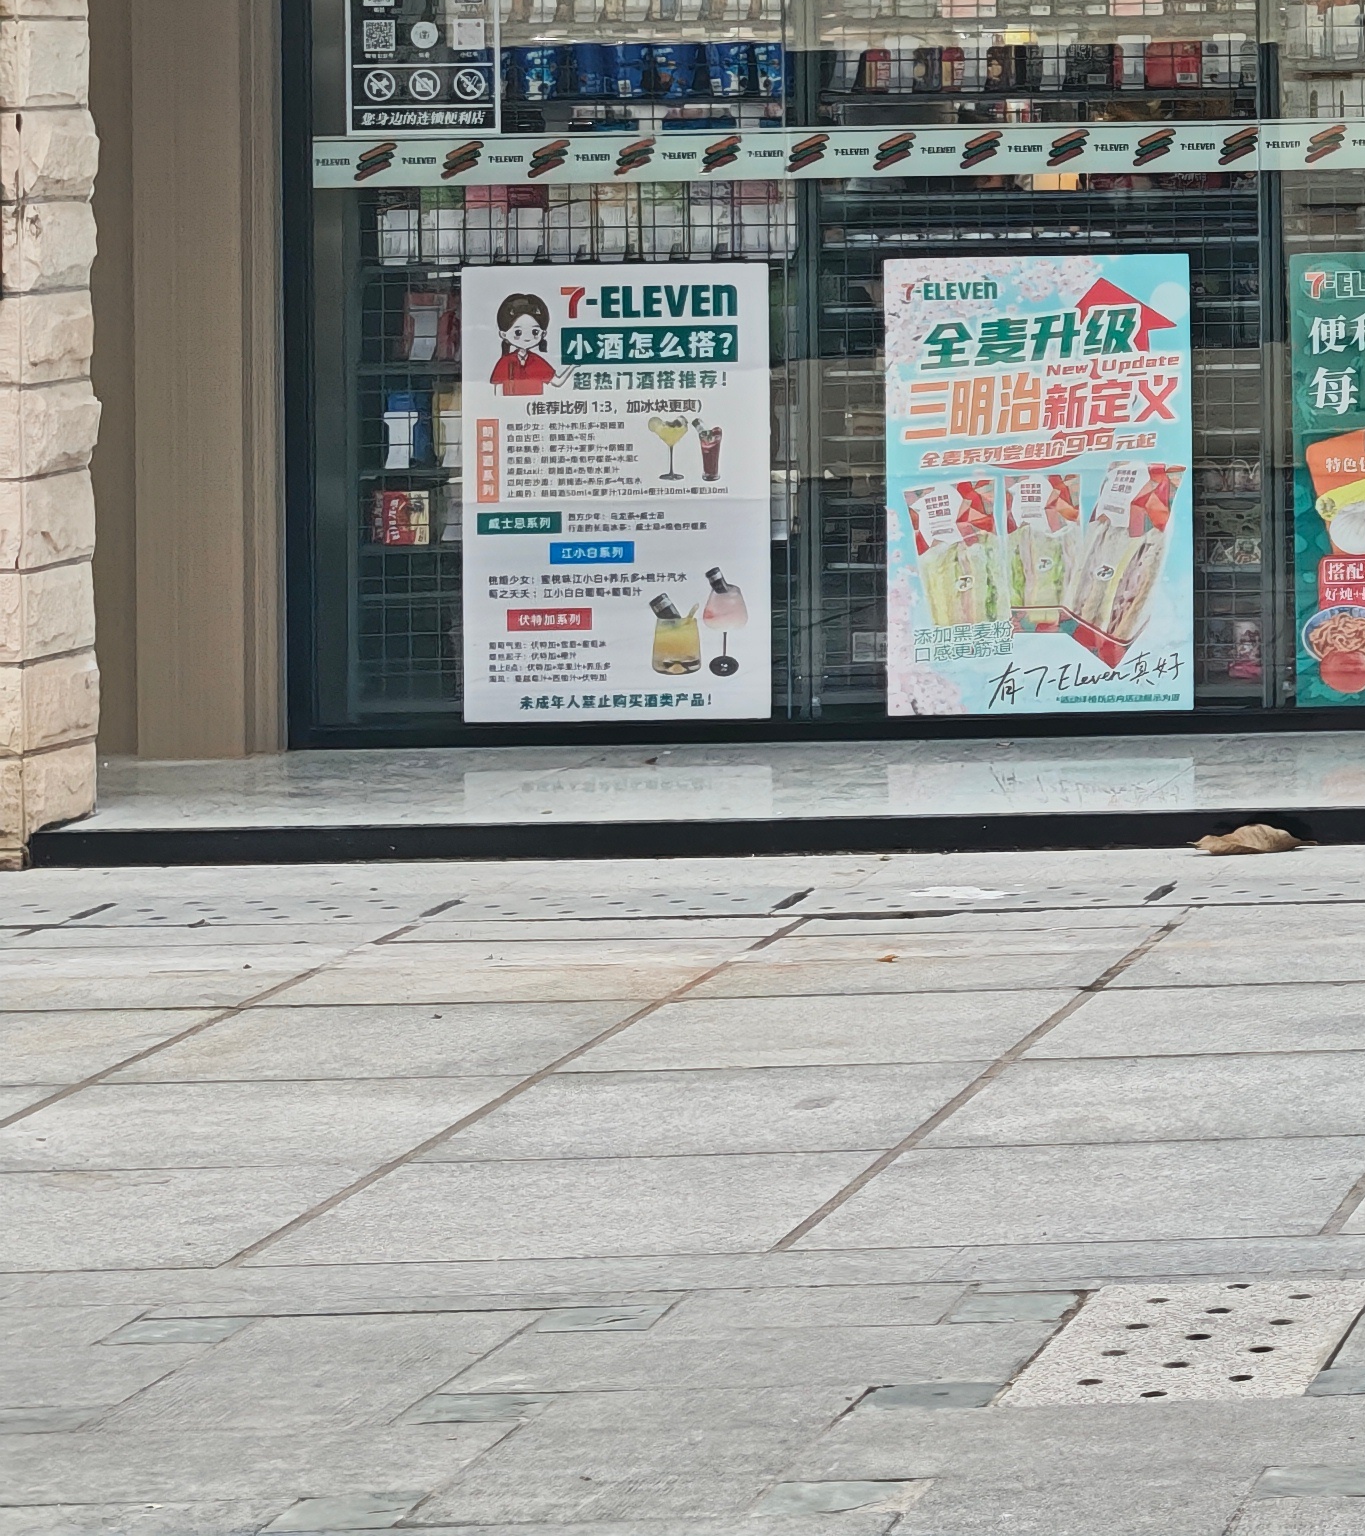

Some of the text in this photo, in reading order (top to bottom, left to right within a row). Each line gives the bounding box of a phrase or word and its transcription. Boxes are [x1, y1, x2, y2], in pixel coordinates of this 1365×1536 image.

[361, 110, 486, 126] 您身边的连锁便利店
[566, 331, 736, 360] 小酒怎么搭？
[921, 308, 1137, 369] 全麦升级
[1046, 356, 1180, 377] New Update
[573, 370, 728, 390] 超热门酒搭推荐！
[904, 374, 1179, 440] 三明治新定义
[561, 546, 624, 559] 江小白系列
[914, 621, 1011, 645] 添加黑麦粉
[914, 640, 1013, 663] 口感更筋道
[519, 693, 713, 710] 未成年人禁止购买酒类产品！
